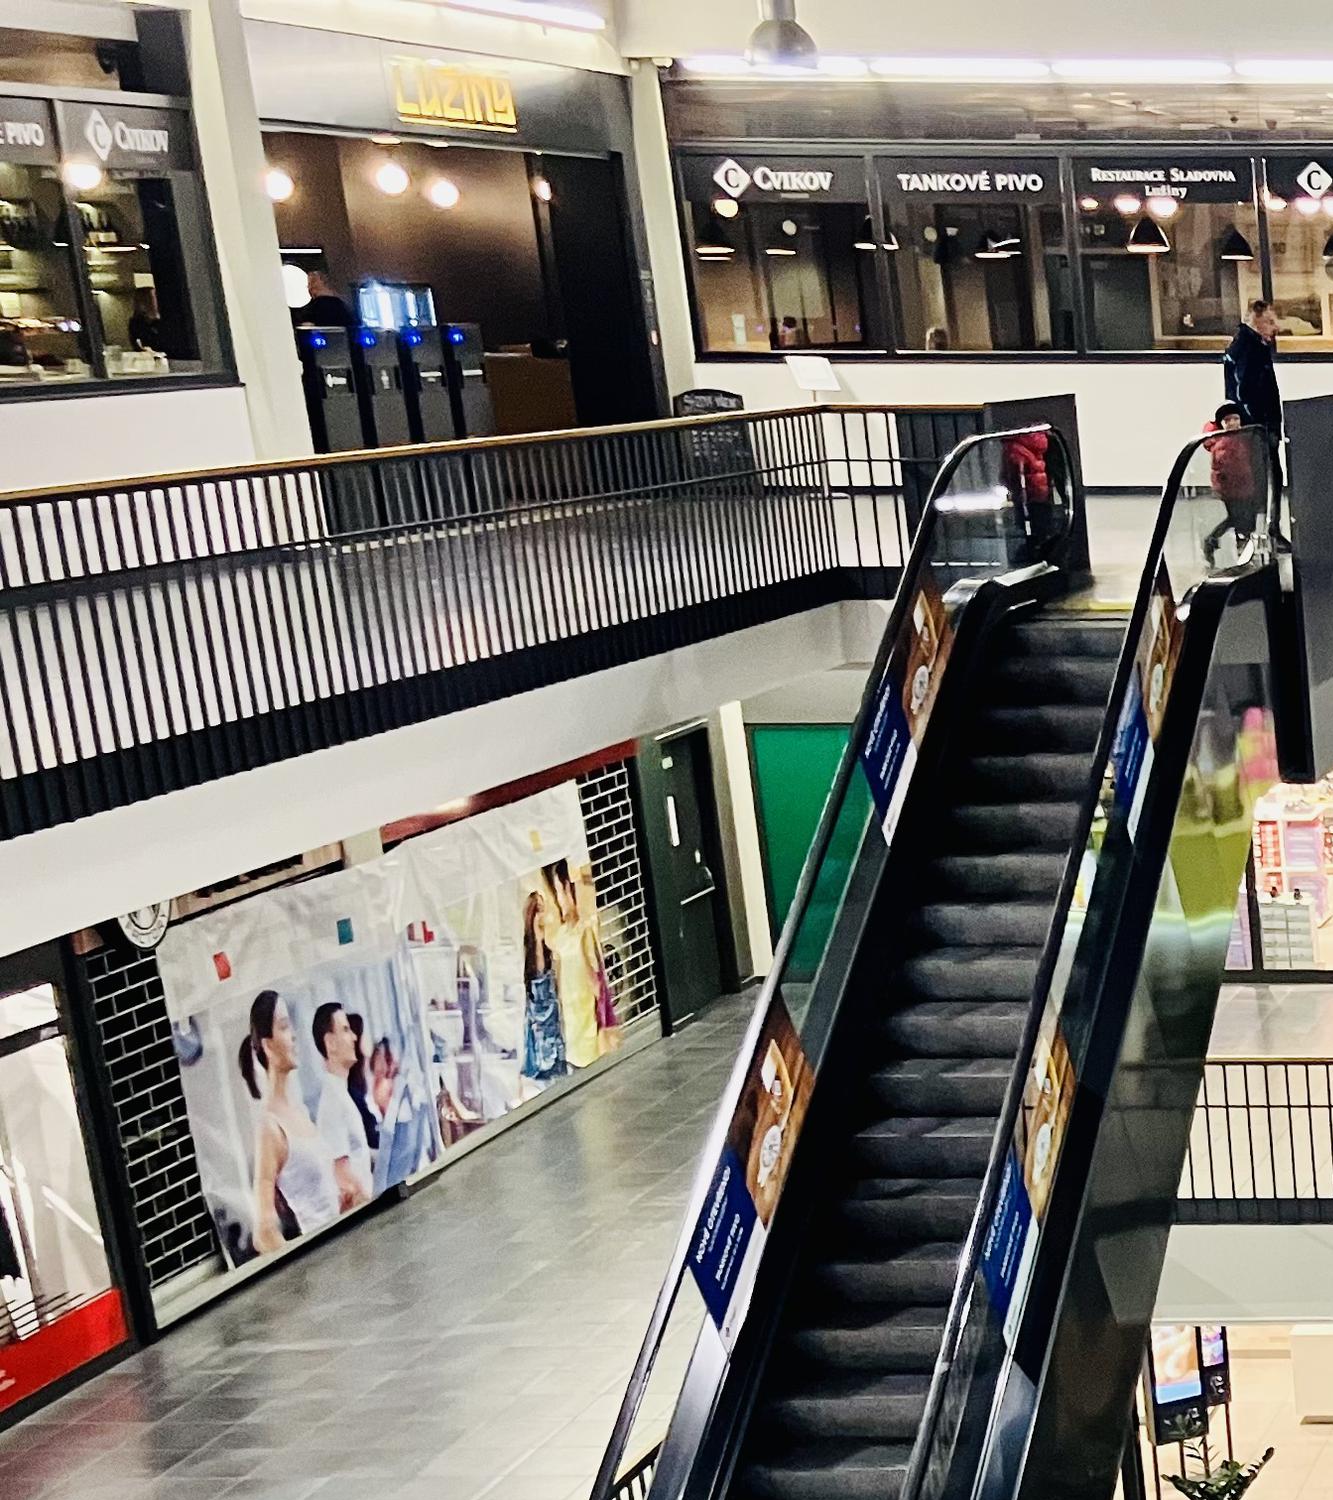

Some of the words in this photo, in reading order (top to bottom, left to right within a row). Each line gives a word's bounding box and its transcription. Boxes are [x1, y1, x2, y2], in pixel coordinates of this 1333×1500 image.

[752, 166, 834, 192] CVIKOV
[897, 170, 992, 192] TANKOVÉ
[995, 173, 1044, 192] PIVO
